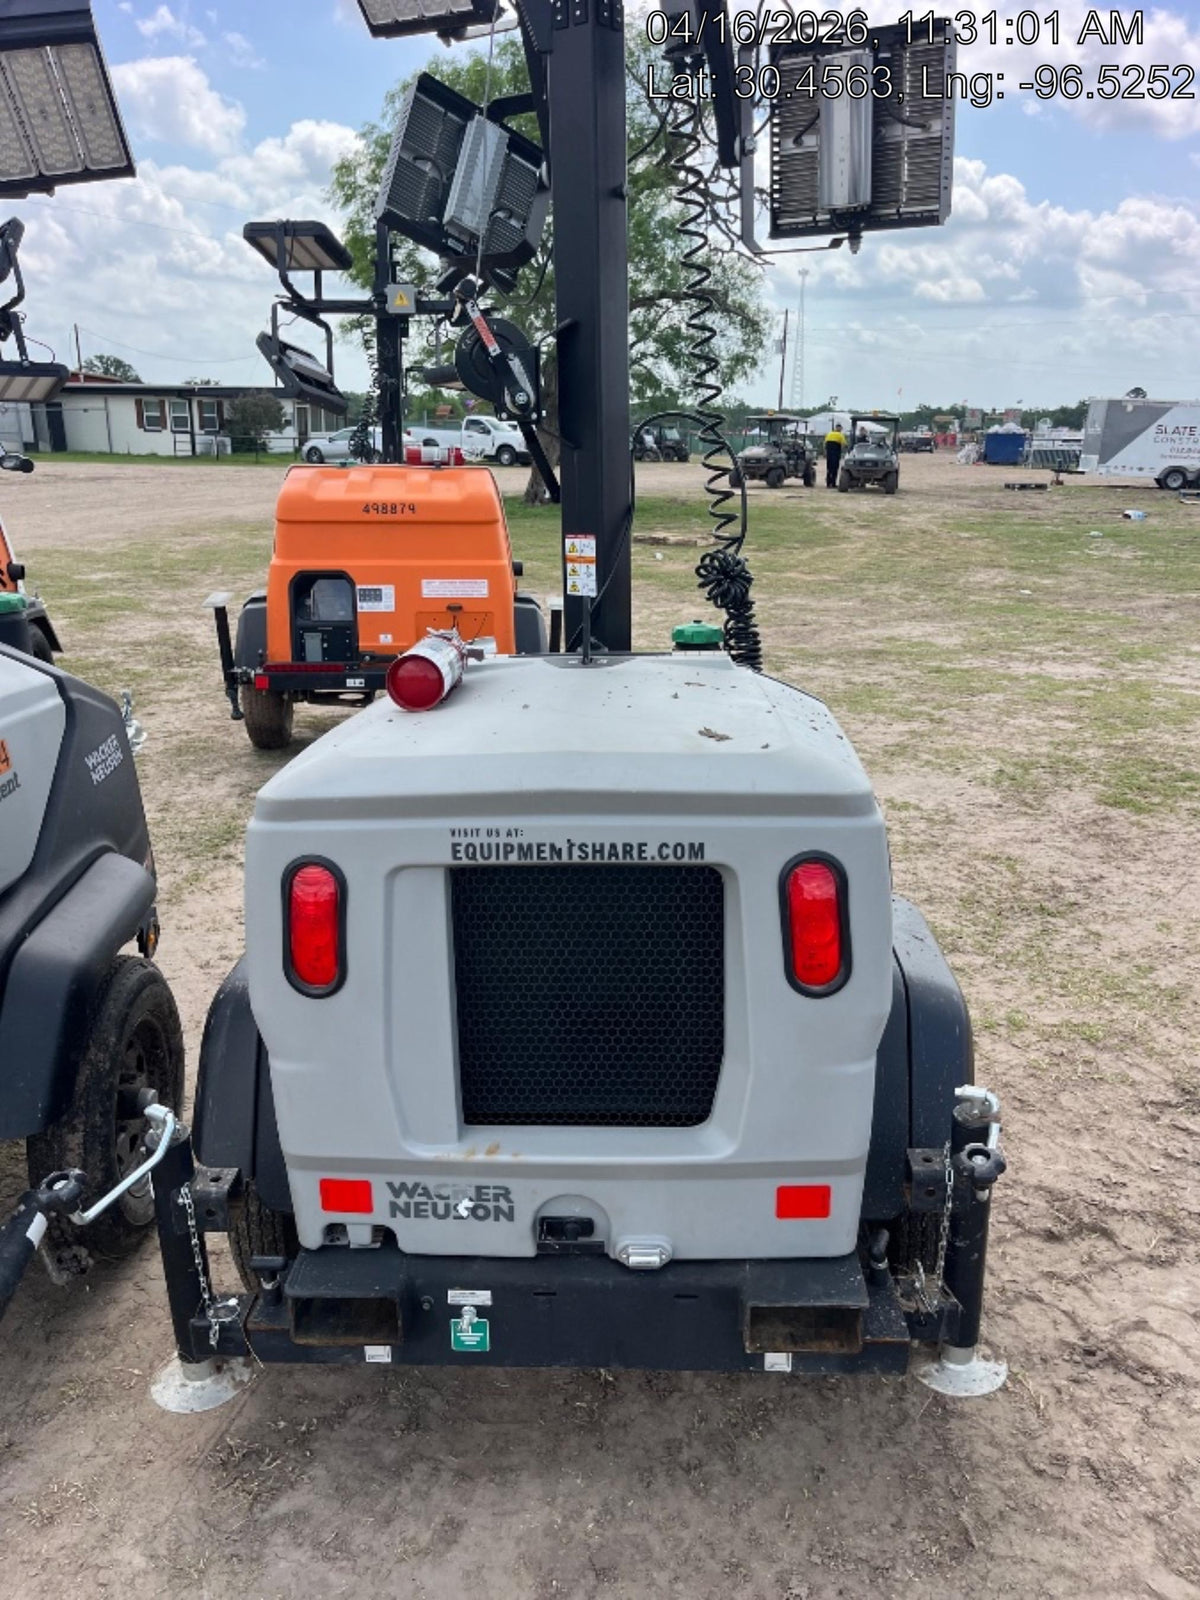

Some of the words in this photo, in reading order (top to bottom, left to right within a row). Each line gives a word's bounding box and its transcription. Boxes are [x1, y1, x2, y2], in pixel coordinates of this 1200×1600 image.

[1155, 424, 1198, 436] SLATE
[450, 828, 480, 838] VISIT
[486, 828, 500, 838] US
[506, 828, 524, 838] AT:
